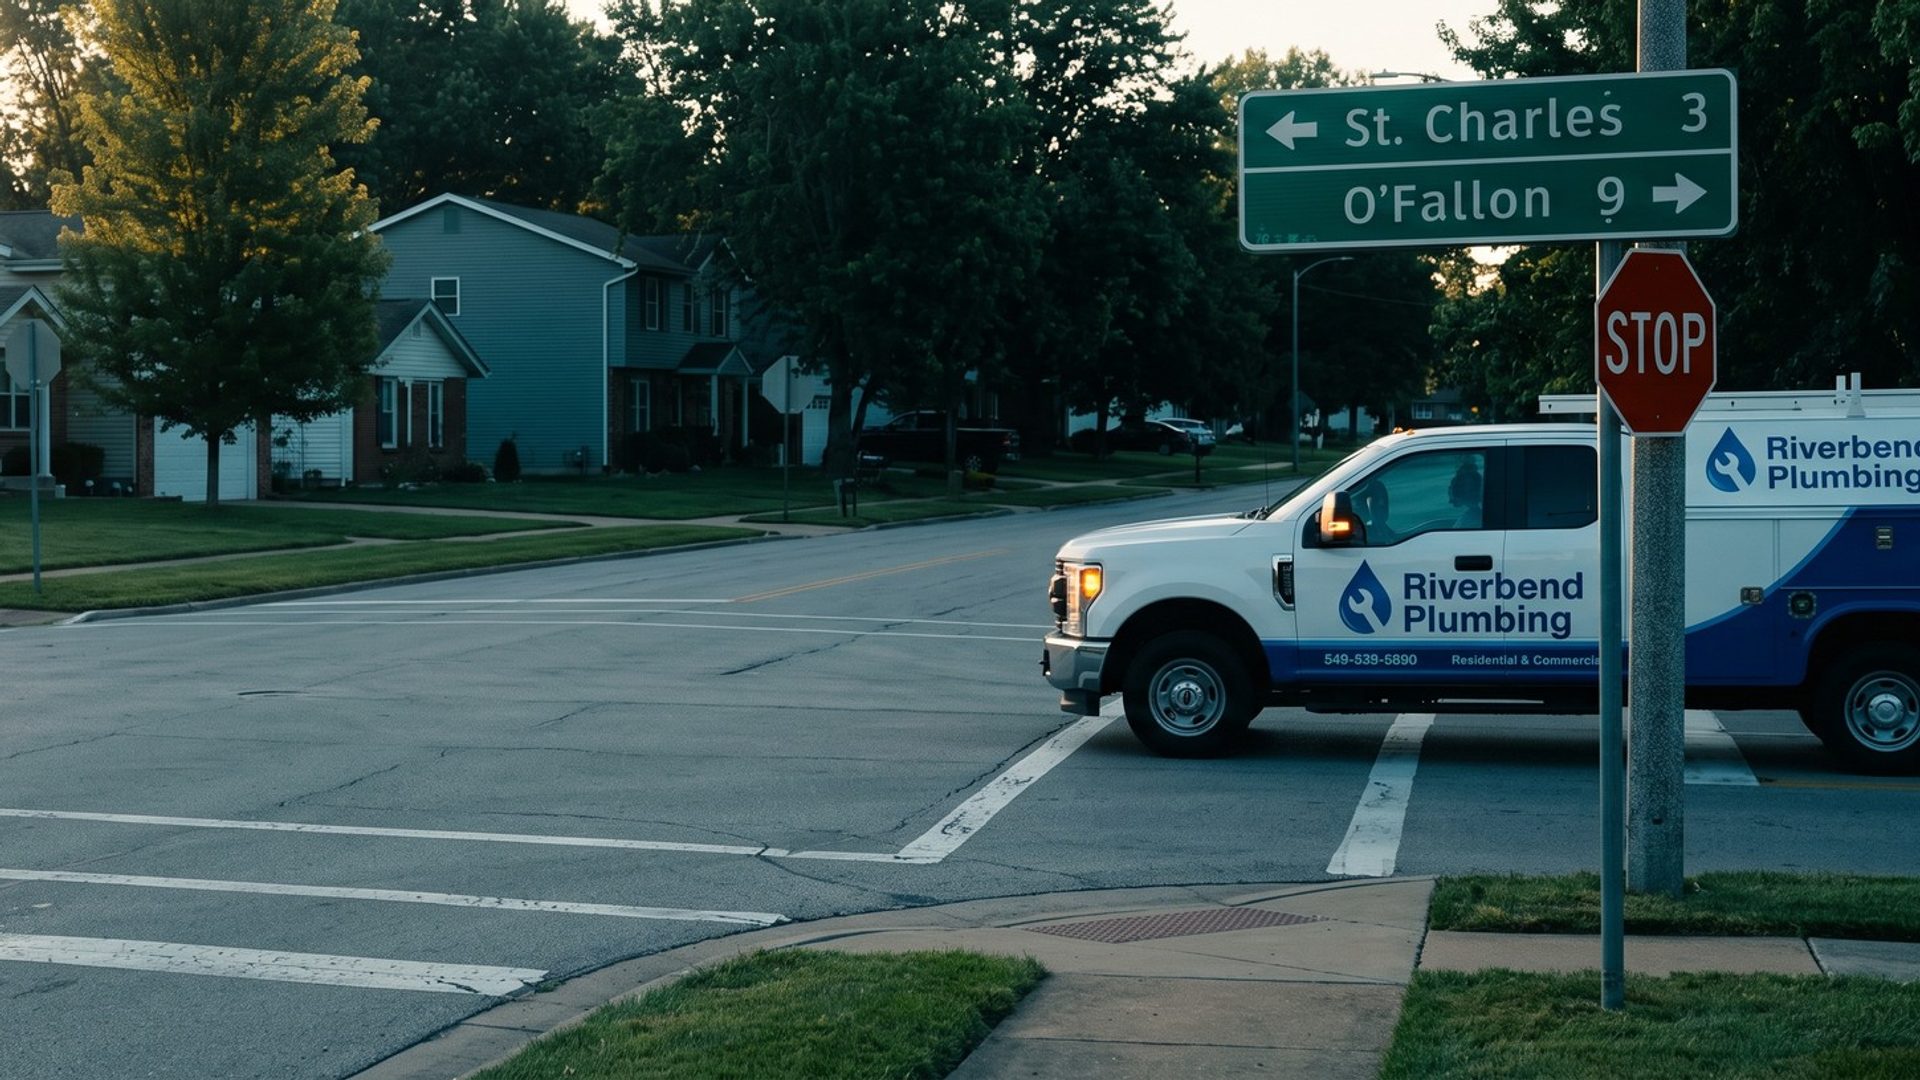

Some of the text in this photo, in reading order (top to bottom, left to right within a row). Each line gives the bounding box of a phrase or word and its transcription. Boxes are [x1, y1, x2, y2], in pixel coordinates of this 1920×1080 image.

[1345, 92, 1708, 147] St. Charles 3
[1344, 176, 1625, 225] O'Fallon 9
[1605, 310, 1706, 375] STOP
[1768, 464, 1920, 494] Plumbing
[1403, 572, 1584, 600] Riverbend
[1404, 605, 1572, 640] Plumbing
[1452, 653, 1518, 666] Residential
[1521, 654, 1530, 666] &
[1533, 654, 1600, 666] Commercia
